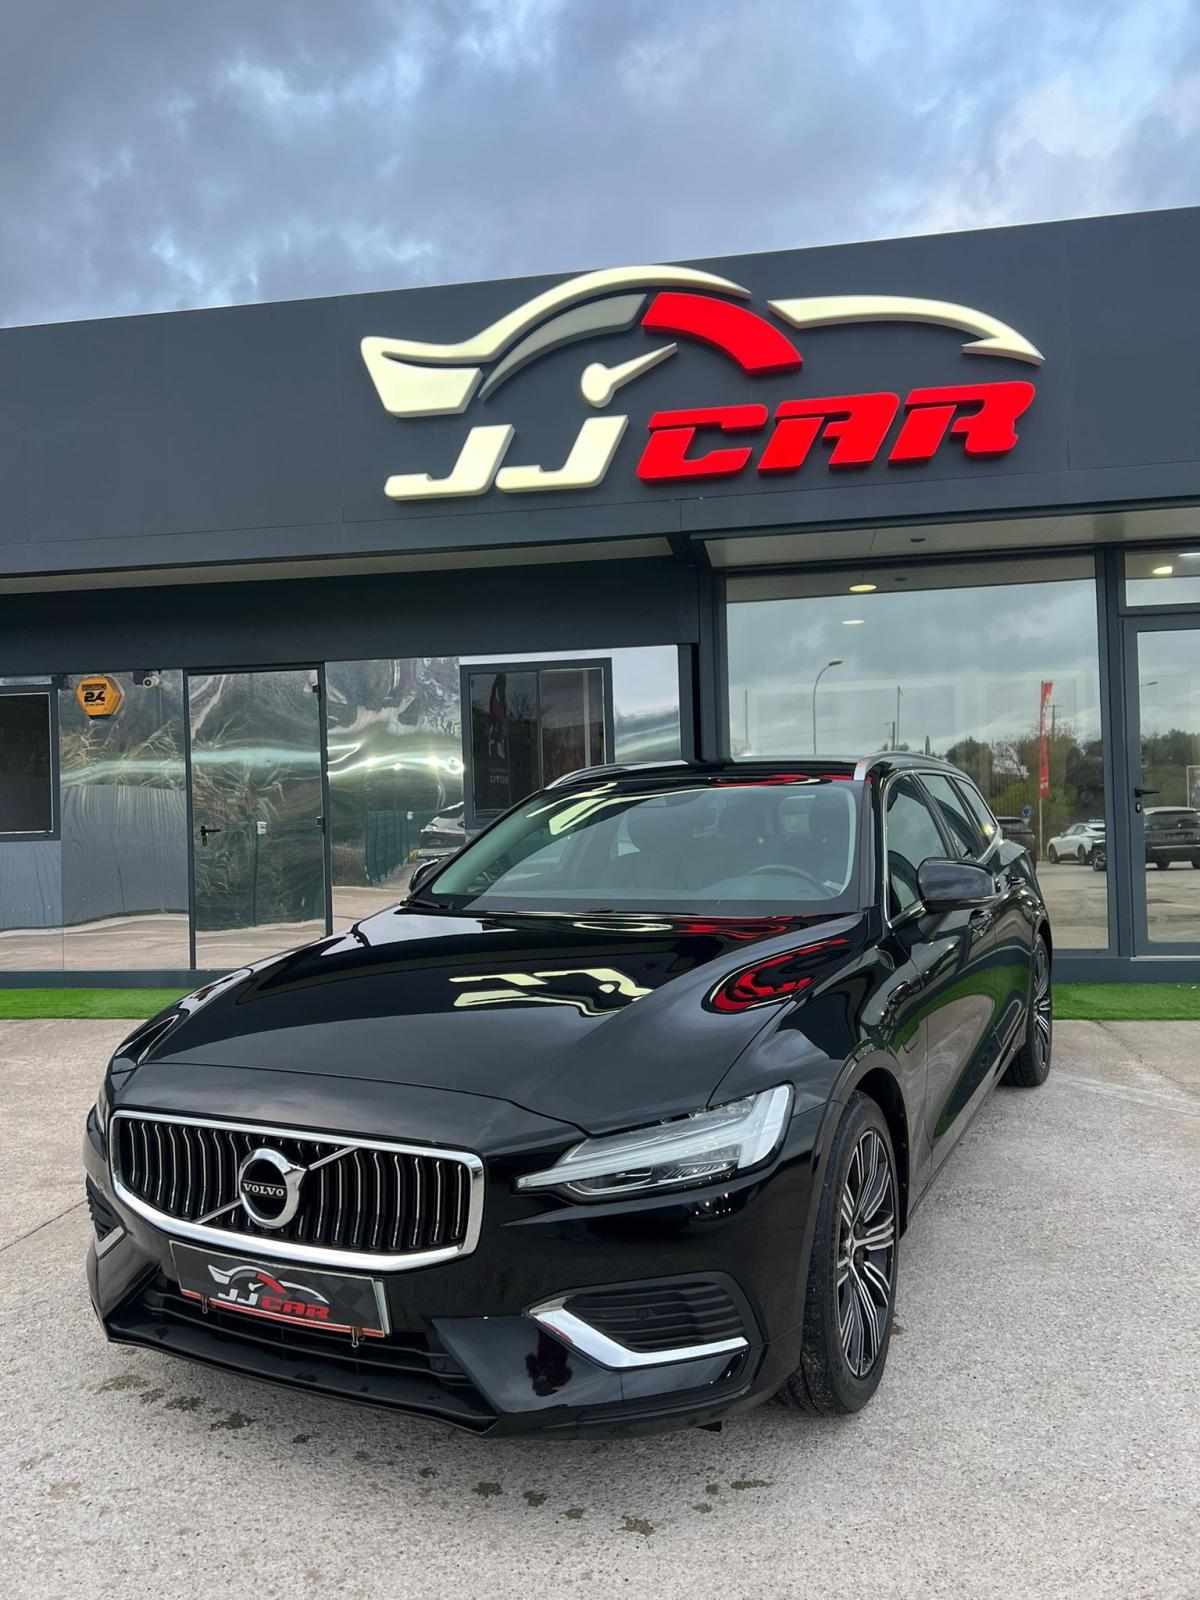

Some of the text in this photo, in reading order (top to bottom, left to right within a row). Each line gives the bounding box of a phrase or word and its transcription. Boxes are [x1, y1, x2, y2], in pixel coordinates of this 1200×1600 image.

[384, 381, 1035, 500] JJ CAR
[243, 1183, 285, 1196] VOLVO
[217, 1288, 331, 1320] JJ CAR
